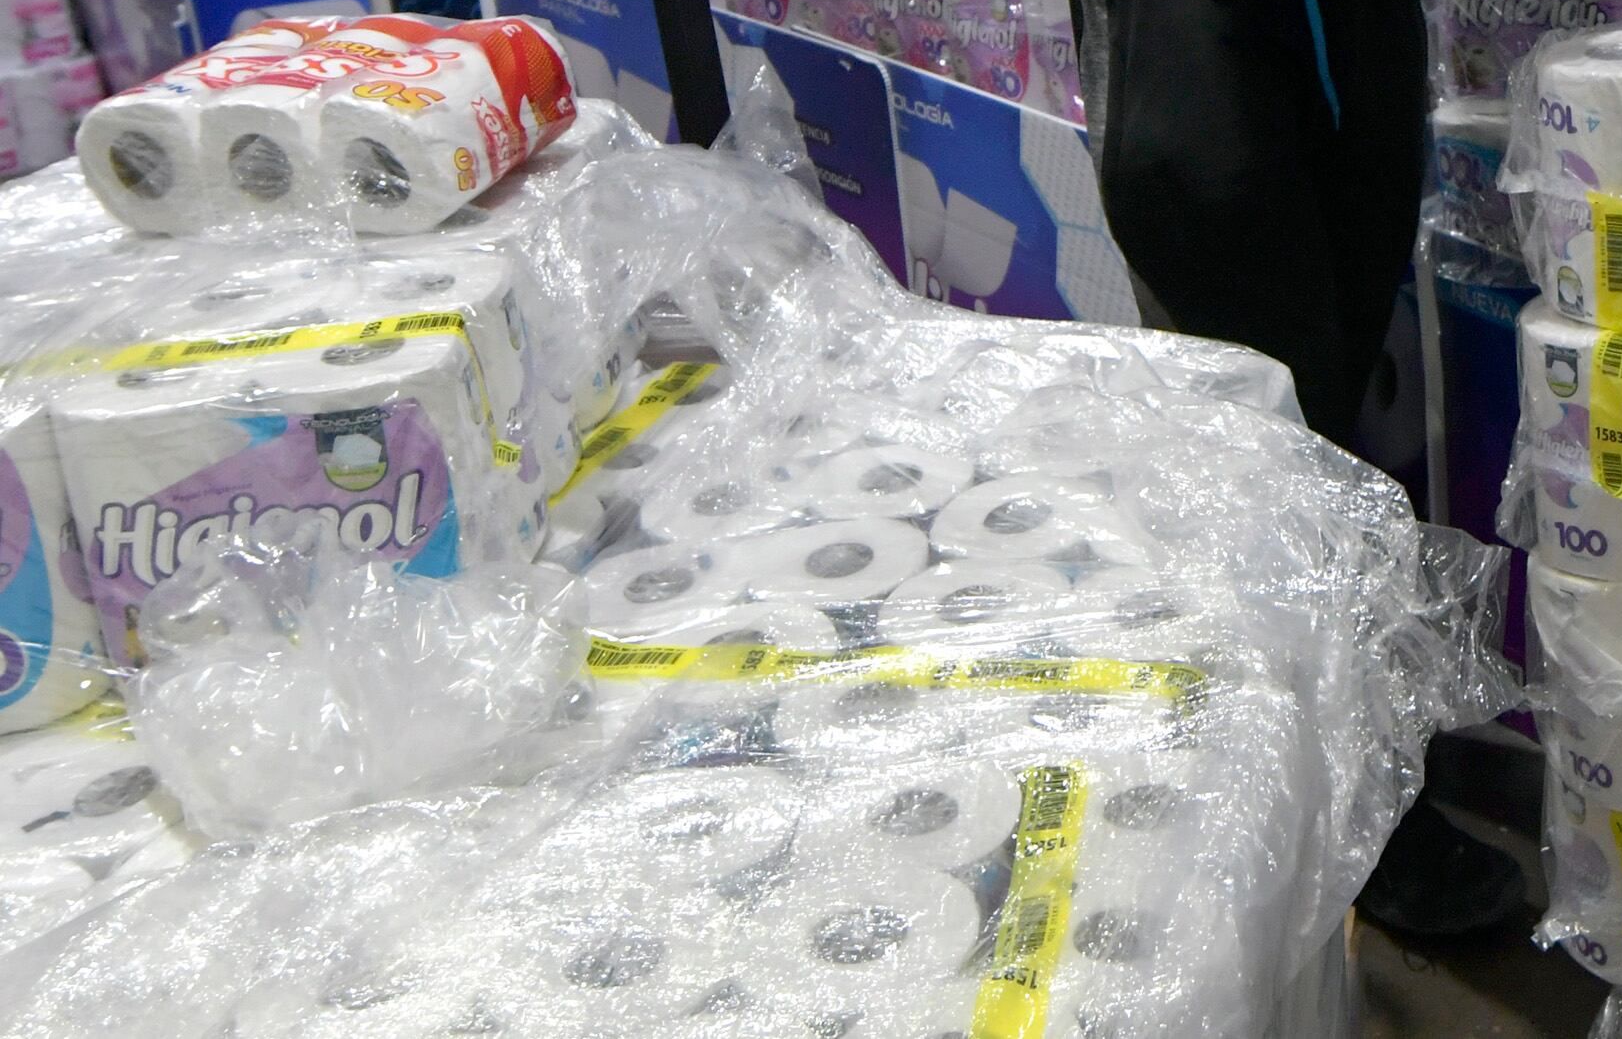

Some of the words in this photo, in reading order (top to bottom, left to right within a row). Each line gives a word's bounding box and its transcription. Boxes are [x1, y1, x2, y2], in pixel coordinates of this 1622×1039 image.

[352, 80, 445, 111] 50
[1586, 114, 1601, 132] 4
[454, 146, 477, 192] 50
[1554, 521, 1608, 558] 100
